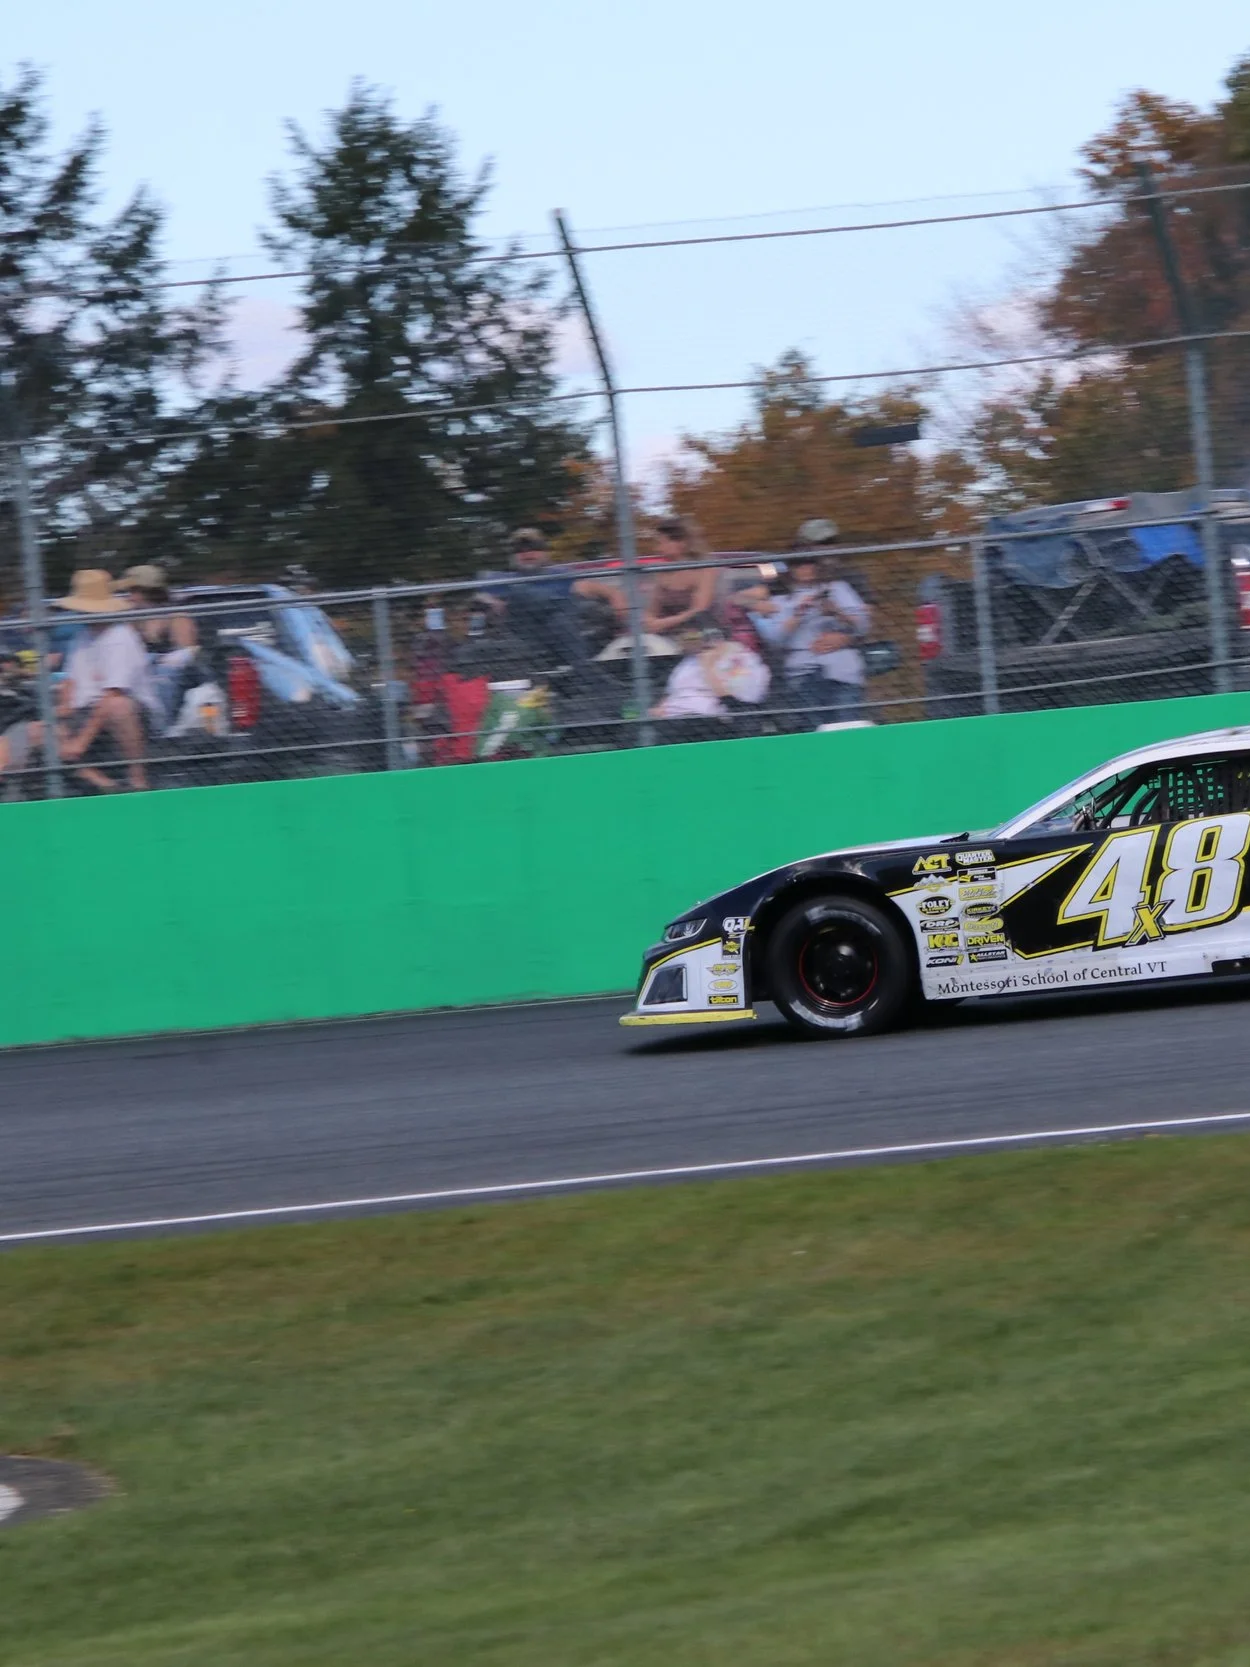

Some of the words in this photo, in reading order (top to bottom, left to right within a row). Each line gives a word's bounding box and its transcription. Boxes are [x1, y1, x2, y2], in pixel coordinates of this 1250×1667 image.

[957, 850, 994, 861] QUARTER
[963, 855, 993, 864] MASTER
[912, 853, 951, 873] ACT
[921, 899, 950, 909] FOLEY
[926, 919, 955, 928] DRP
[966, 935, 1004, 945] DRIVEN
[937, 976, 1018, 996] Montessori
[1021, 970, 1068, 986] School
[1073, 968, 1087, 980] of
[1090, 963, 1142, 980] Central
[1146, 961, 1167, 973] VT
